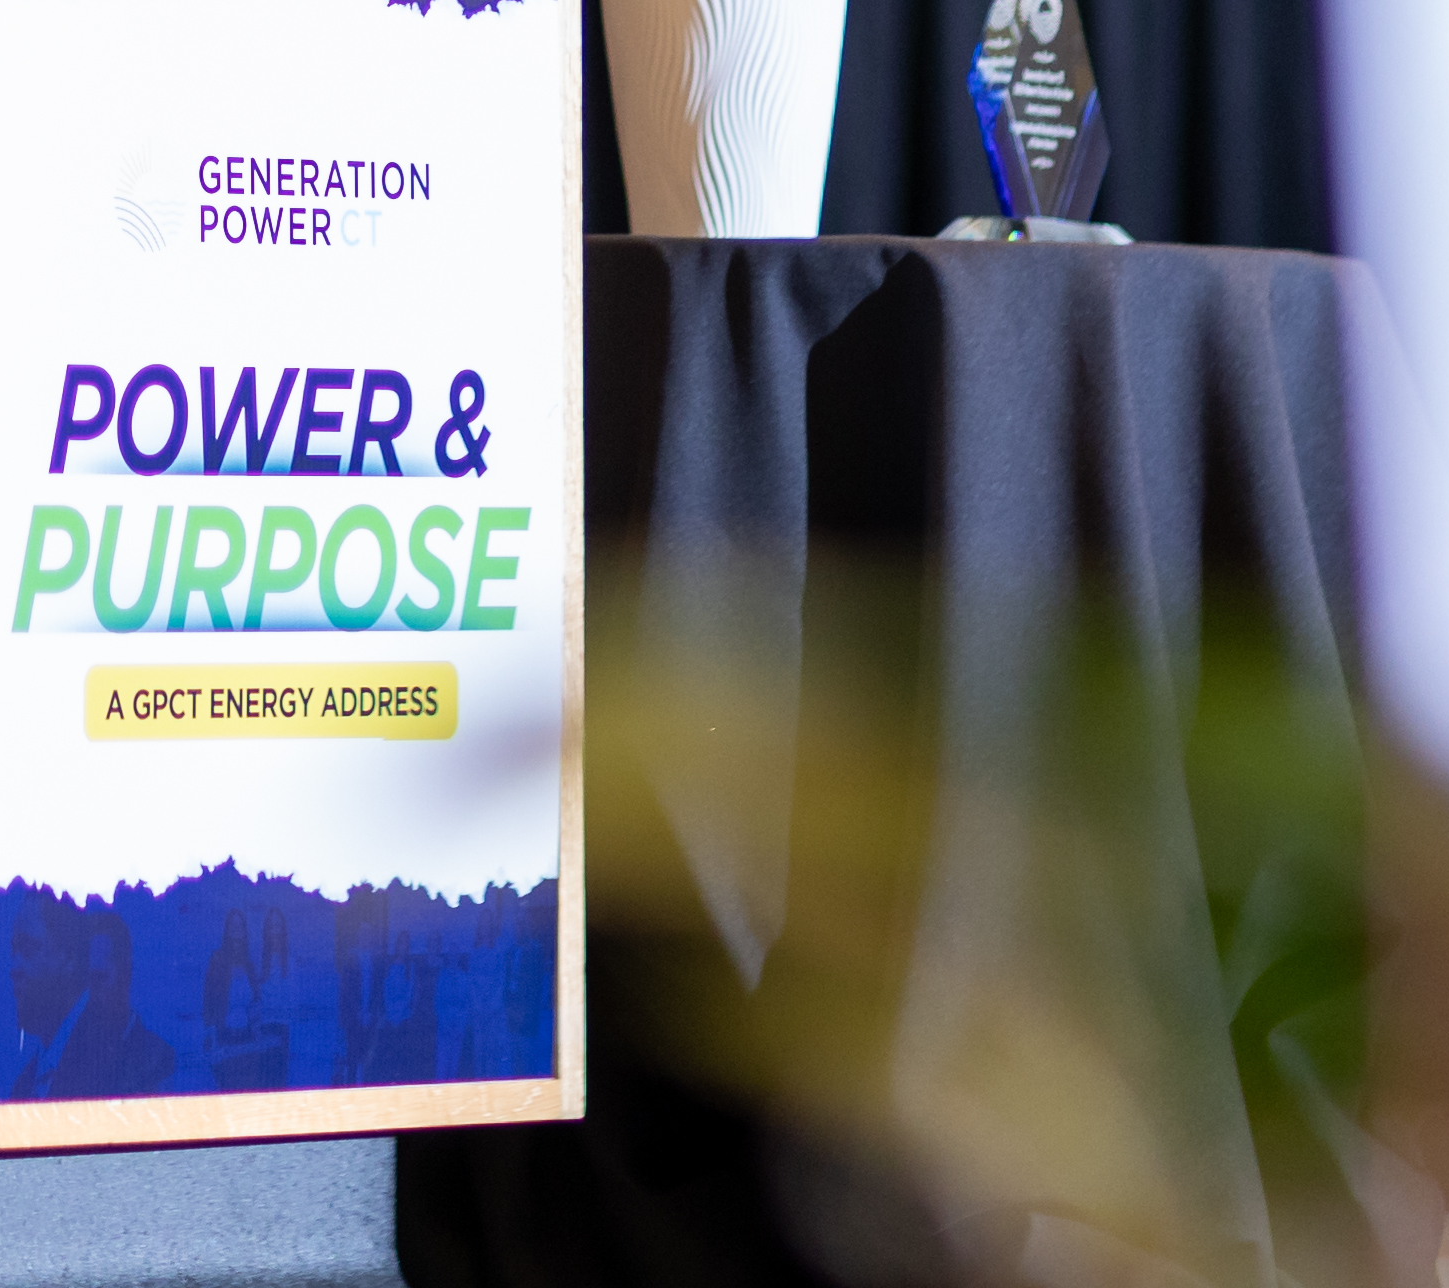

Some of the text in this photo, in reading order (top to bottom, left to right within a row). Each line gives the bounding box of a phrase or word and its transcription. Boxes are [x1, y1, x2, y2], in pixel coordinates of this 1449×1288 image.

[199, 155, 430, 200] GENERATION
[48, 363, 492, 478] POWER &
[11, 504, 532, 633] PURPOSE
[105, 685, 439, 720] A GPCT ENERGY ADDRESS
